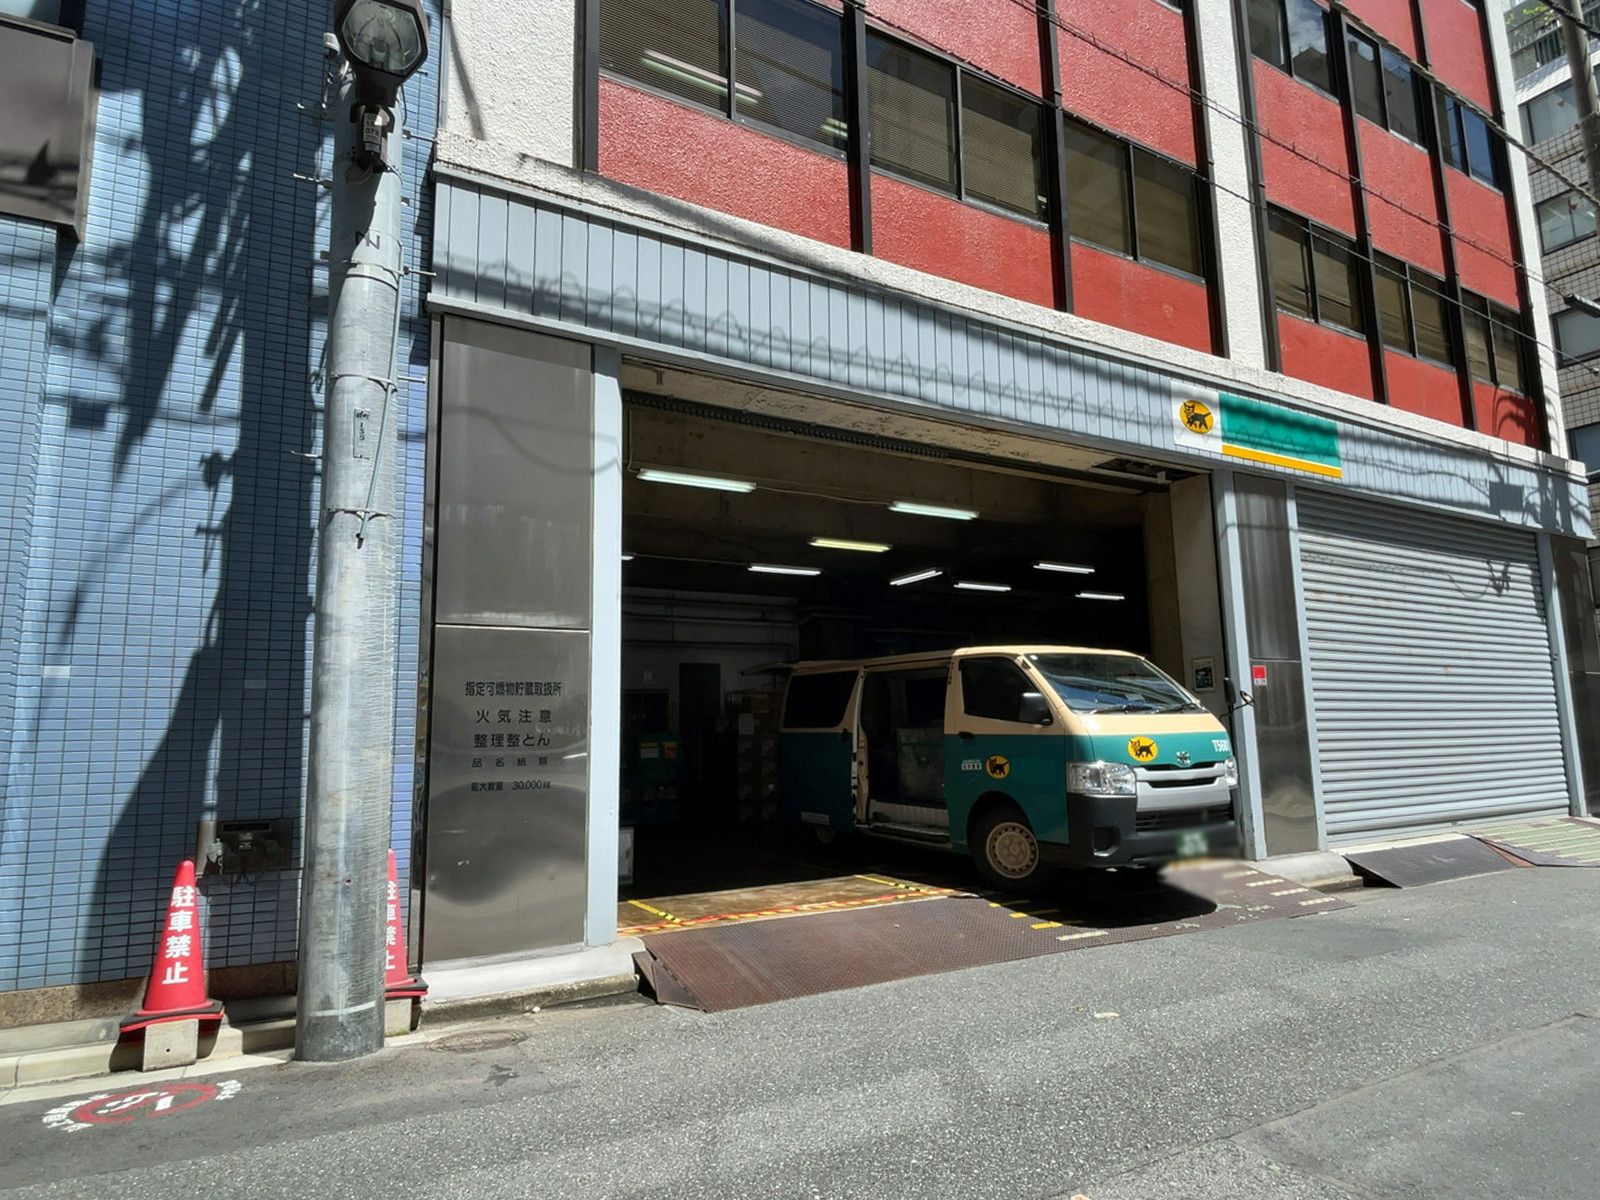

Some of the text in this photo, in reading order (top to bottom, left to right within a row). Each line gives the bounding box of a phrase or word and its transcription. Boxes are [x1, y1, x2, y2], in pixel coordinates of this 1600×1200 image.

[475, 708, 552, 724] 火気注意
[473, 733, 551, 748] 整理整とん
[161, 885, 195, 985] 駐車禁止
